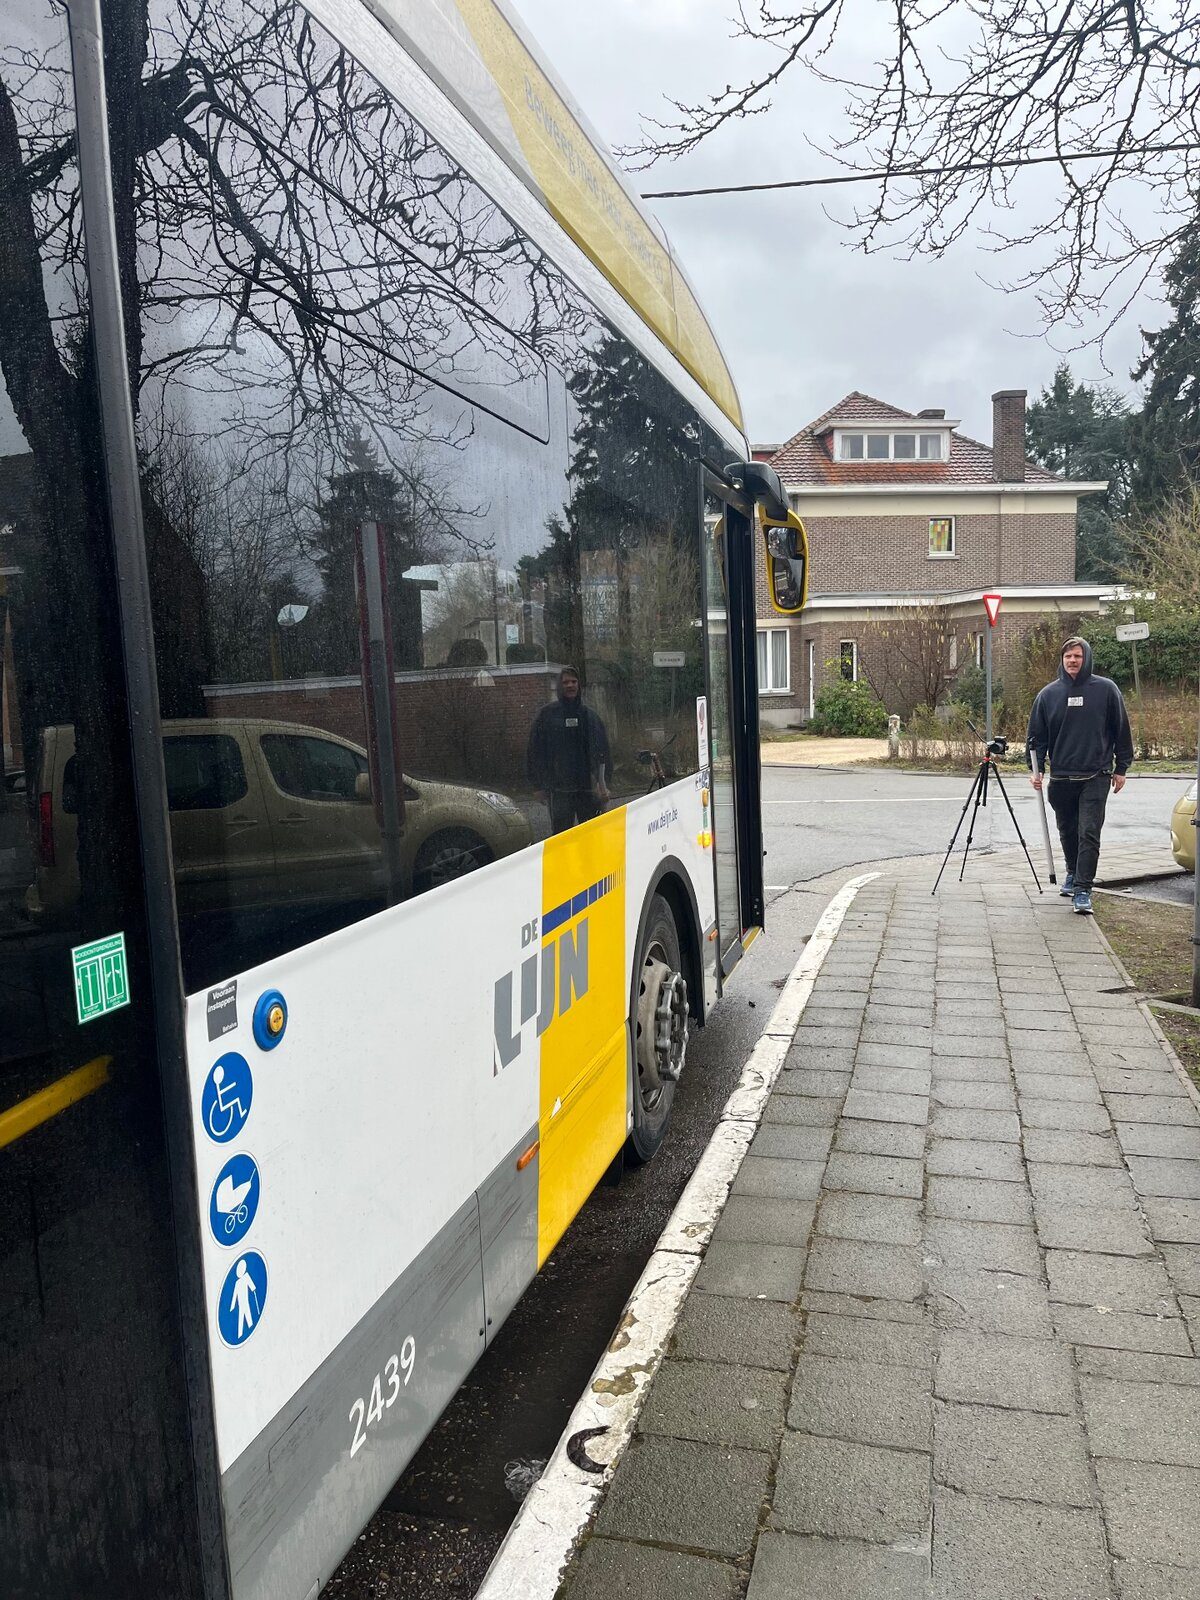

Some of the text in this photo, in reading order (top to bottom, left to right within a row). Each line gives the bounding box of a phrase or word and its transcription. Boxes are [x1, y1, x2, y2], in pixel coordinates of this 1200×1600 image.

[74, 939, 121, 959] NOODONTGRENDELING
[521, 917, 538, 949] DE
[212, 985, 236, 1000] Vooraan
[494, 916, 589, 1078] LIJN
[349, 1334, 416, 1458] 2439
